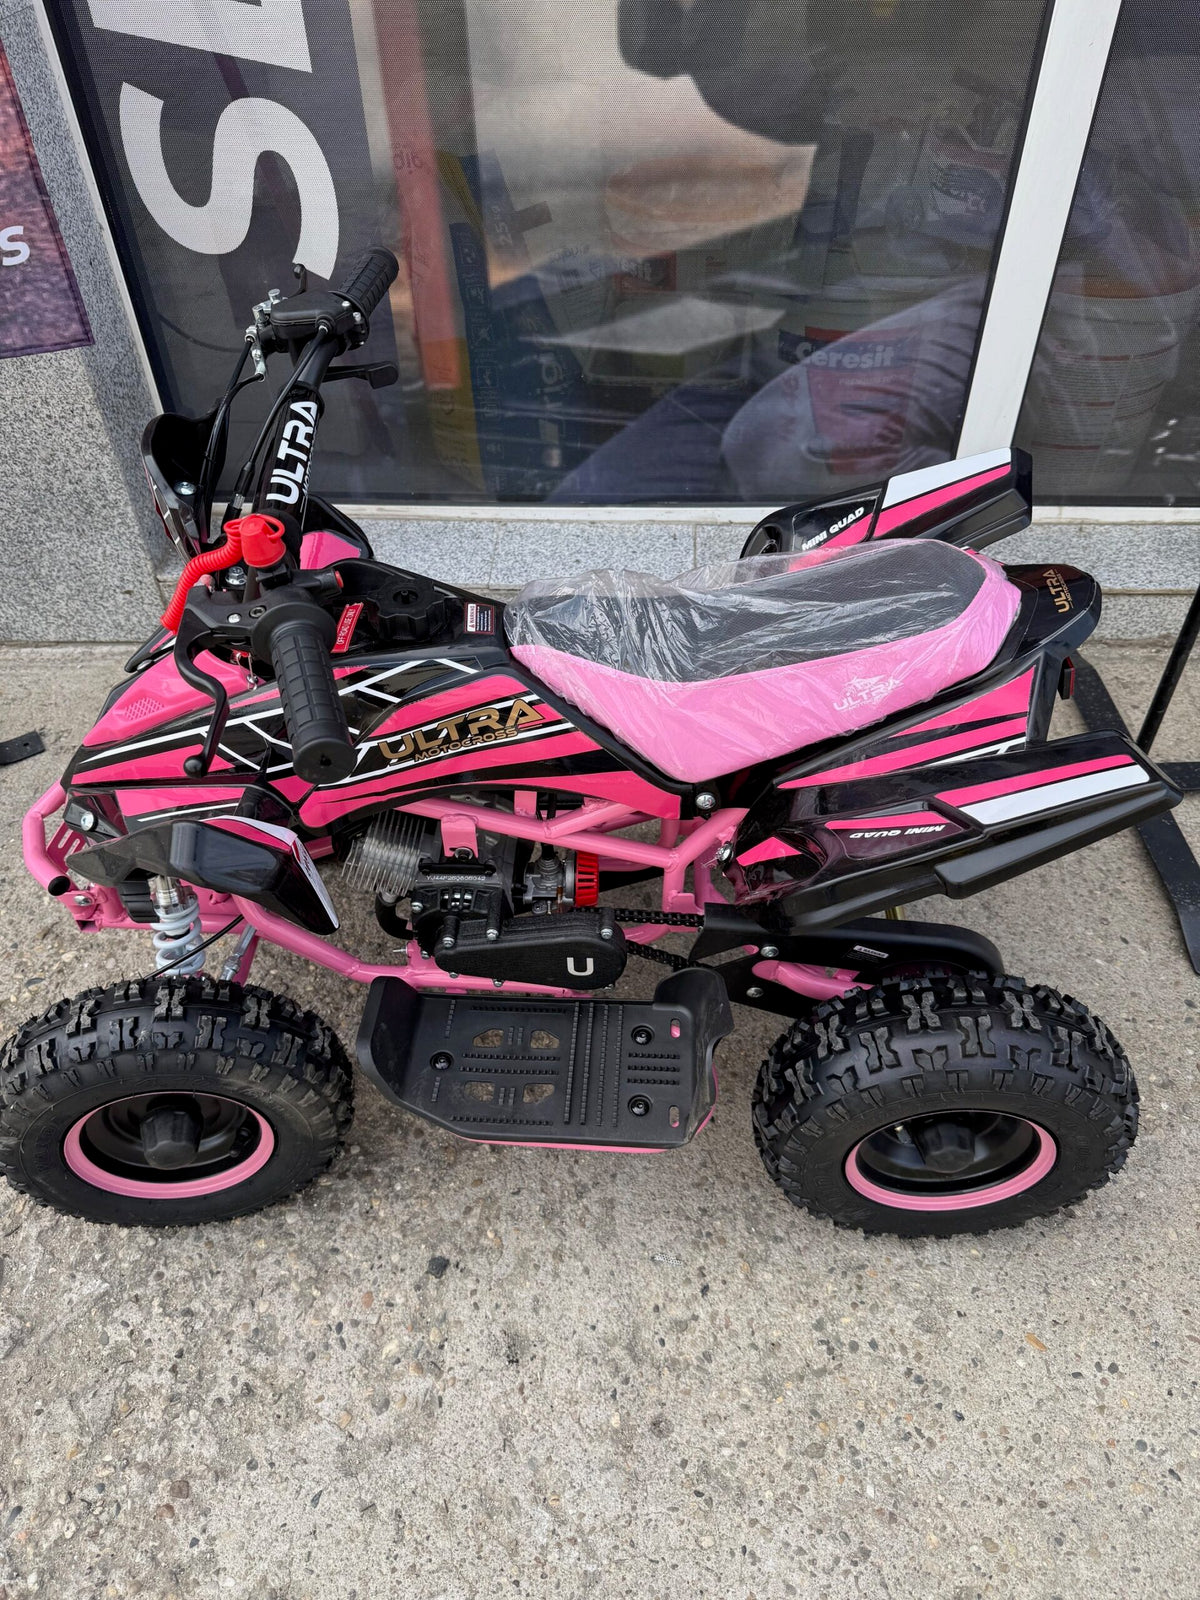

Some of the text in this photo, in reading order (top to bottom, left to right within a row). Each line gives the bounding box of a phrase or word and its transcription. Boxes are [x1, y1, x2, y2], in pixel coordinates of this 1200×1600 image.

[266, 401, 318, 505] ULTRA
[801, 506, 866, 551] MINI QUAD
[1042, 569, 1070, 614] ULTRA
[833, 677, 902, 711] ULTRA
[377, 698, 546, 760] ULTRA
[414, 728, 518, 762] MOTOCROSS
[849, 824, 946, 839] MINI QUAD
[566, 956, 594, 976] U
